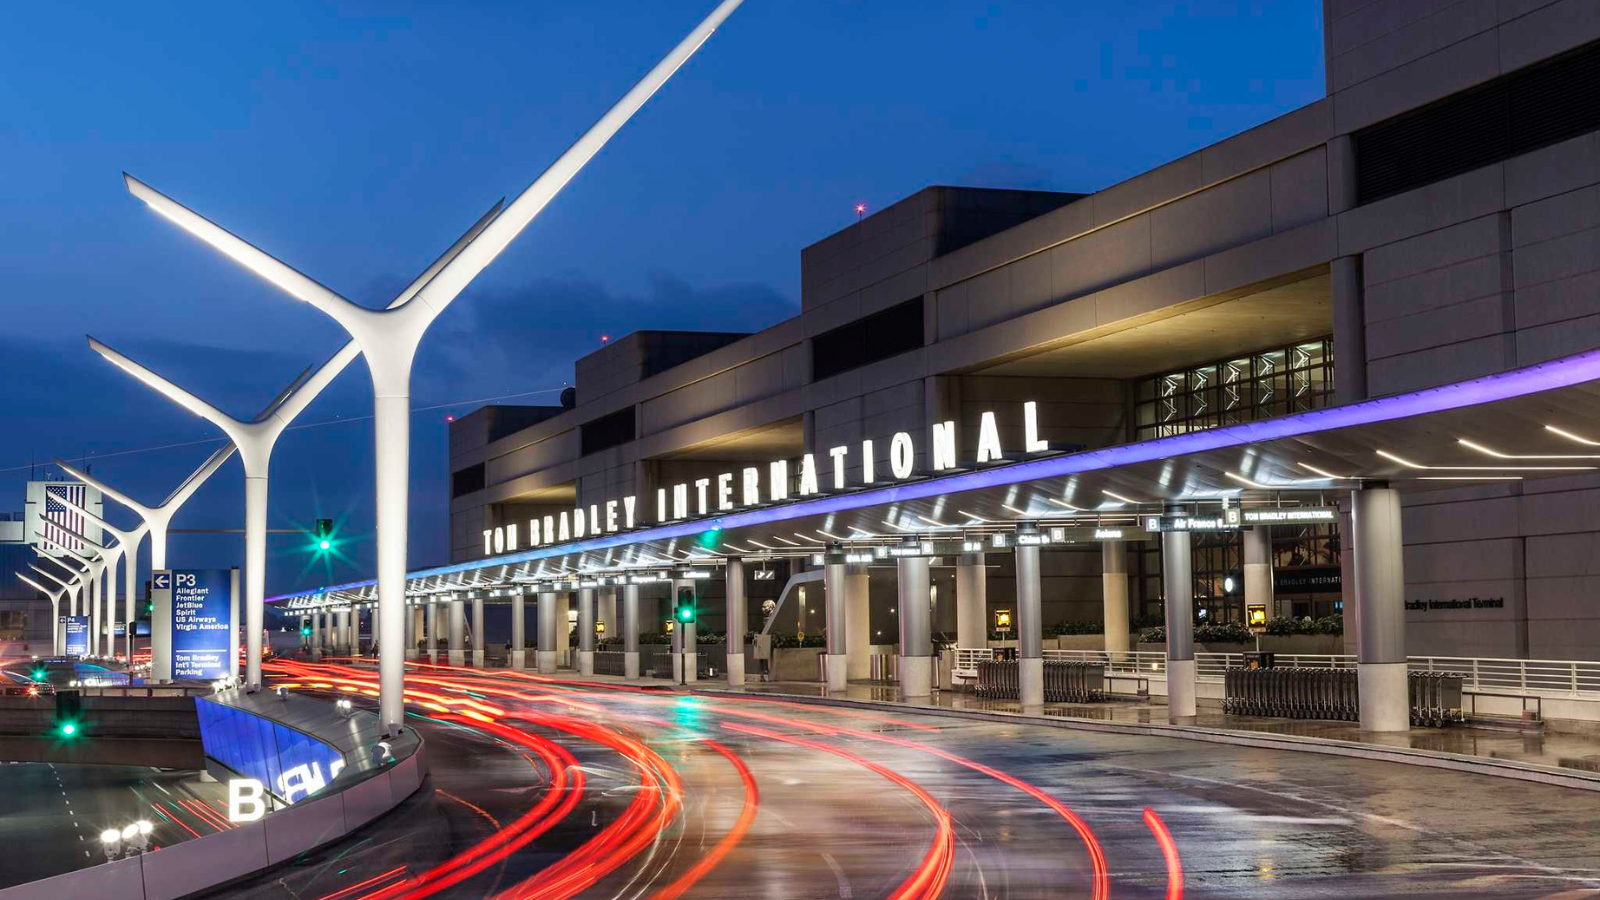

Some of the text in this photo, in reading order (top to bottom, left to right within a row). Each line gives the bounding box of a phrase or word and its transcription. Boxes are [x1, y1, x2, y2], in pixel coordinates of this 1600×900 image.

[483, 401, 1049, 555] TOM BRADLEY INTERNATIONAL
[1244, 512, 1259, 521] TOM
[1259, 511, 1287, 520] BRADLEY
[1287, 510, 1334, 520] INTERNATIONAL
[1148, 518, 1158, 529] B
[1174, 518, 1187, 528] Air
[1187, 518, 1215, 528] France
[176, 574, 196, 587] P3
[176, 587, 209, 595] Allegiant
[1428, 598, 1472, 610] International
[1472, 597, 1504, 609] Terminal
[175, 609, 197, 617] Spirit
[187, 616, 217, 624] Airways
[175, 623, 198, 631] Virgin
[175, 654, 220, 662] Tom Bradley
[190, 661, 221, 669] Terminal
[175, 668, 203, 677] Parking
[228, 778, 266, 823] B
